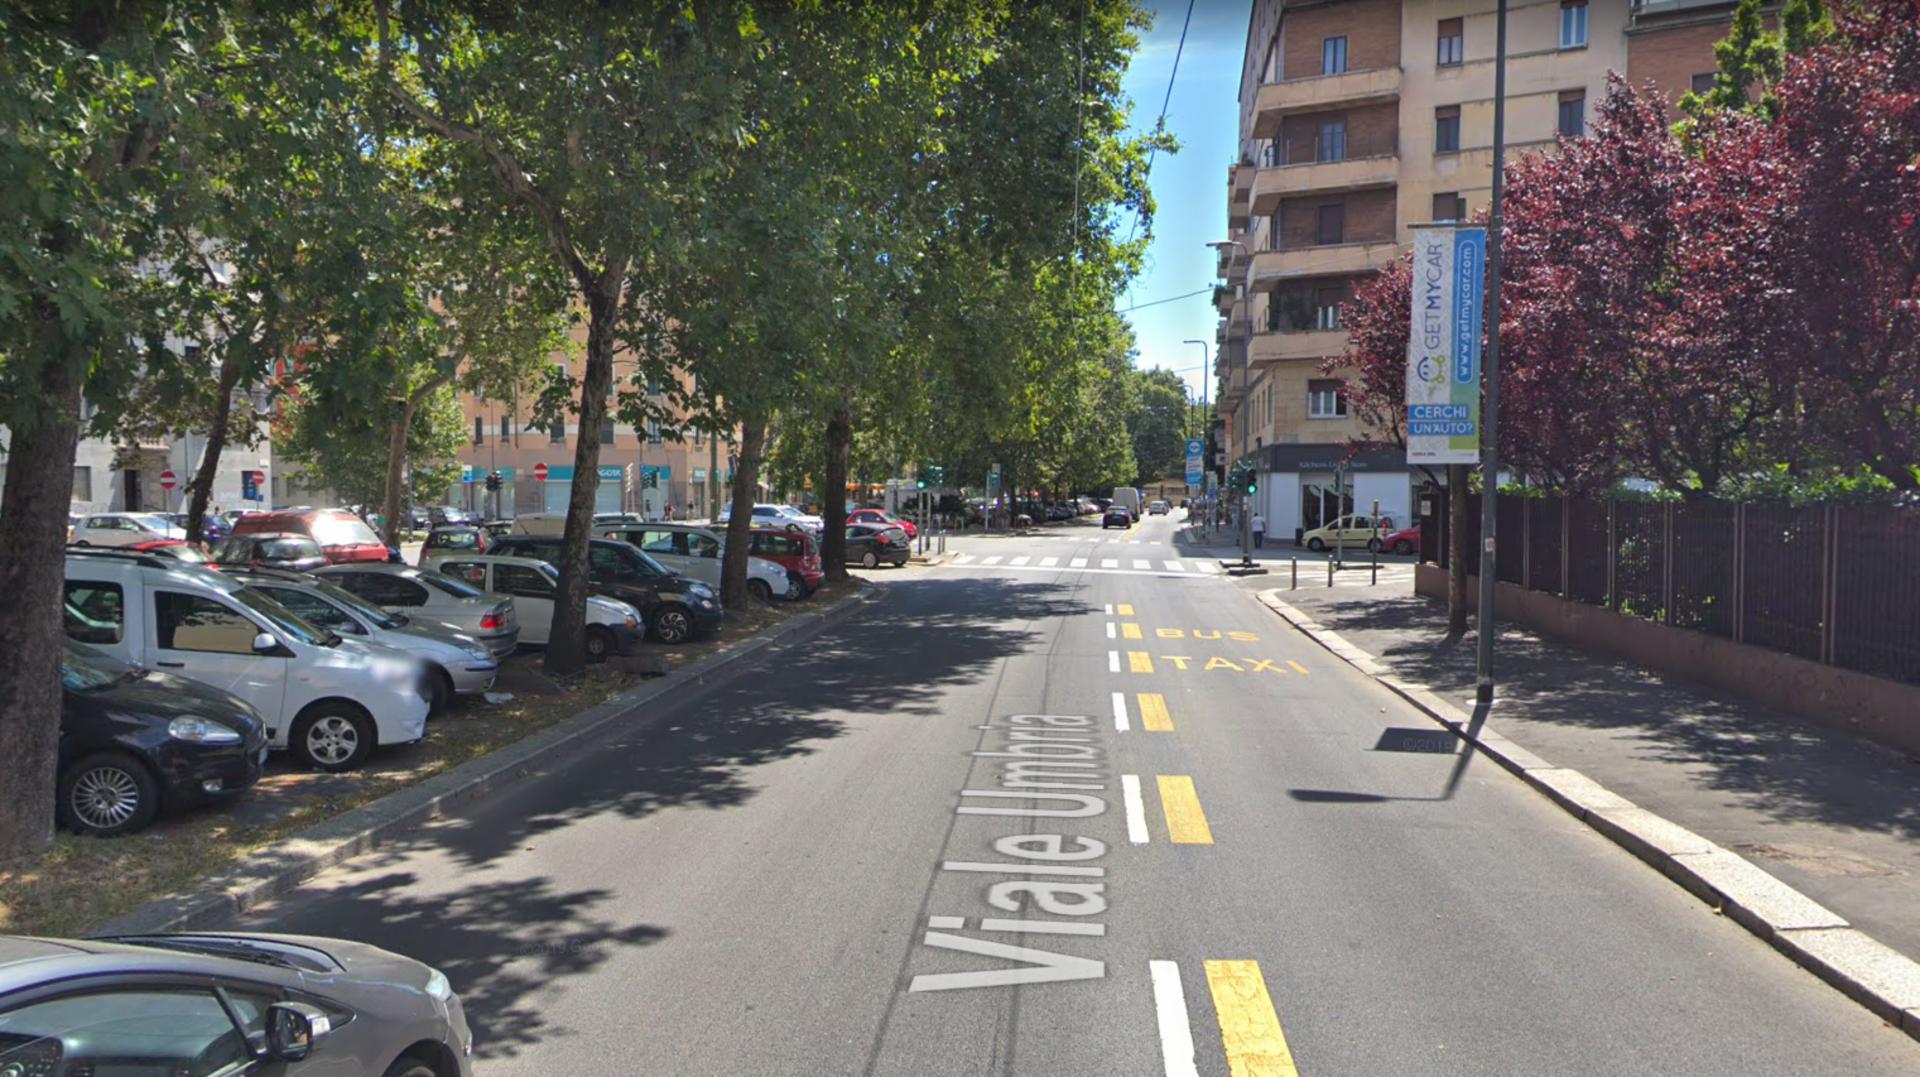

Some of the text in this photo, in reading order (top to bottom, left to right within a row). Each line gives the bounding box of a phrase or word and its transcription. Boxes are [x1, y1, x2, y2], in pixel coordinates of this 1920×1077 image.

[1424, 242, 1442, 350] GETMYCAR
[1460, 247, 1473, 376] www.getmycar.com
[1414, 406, 1467, 418] CERCHI
[1155, 627, 1261, 641] BUS
[1160, 655, 1310, 675] TAXI
